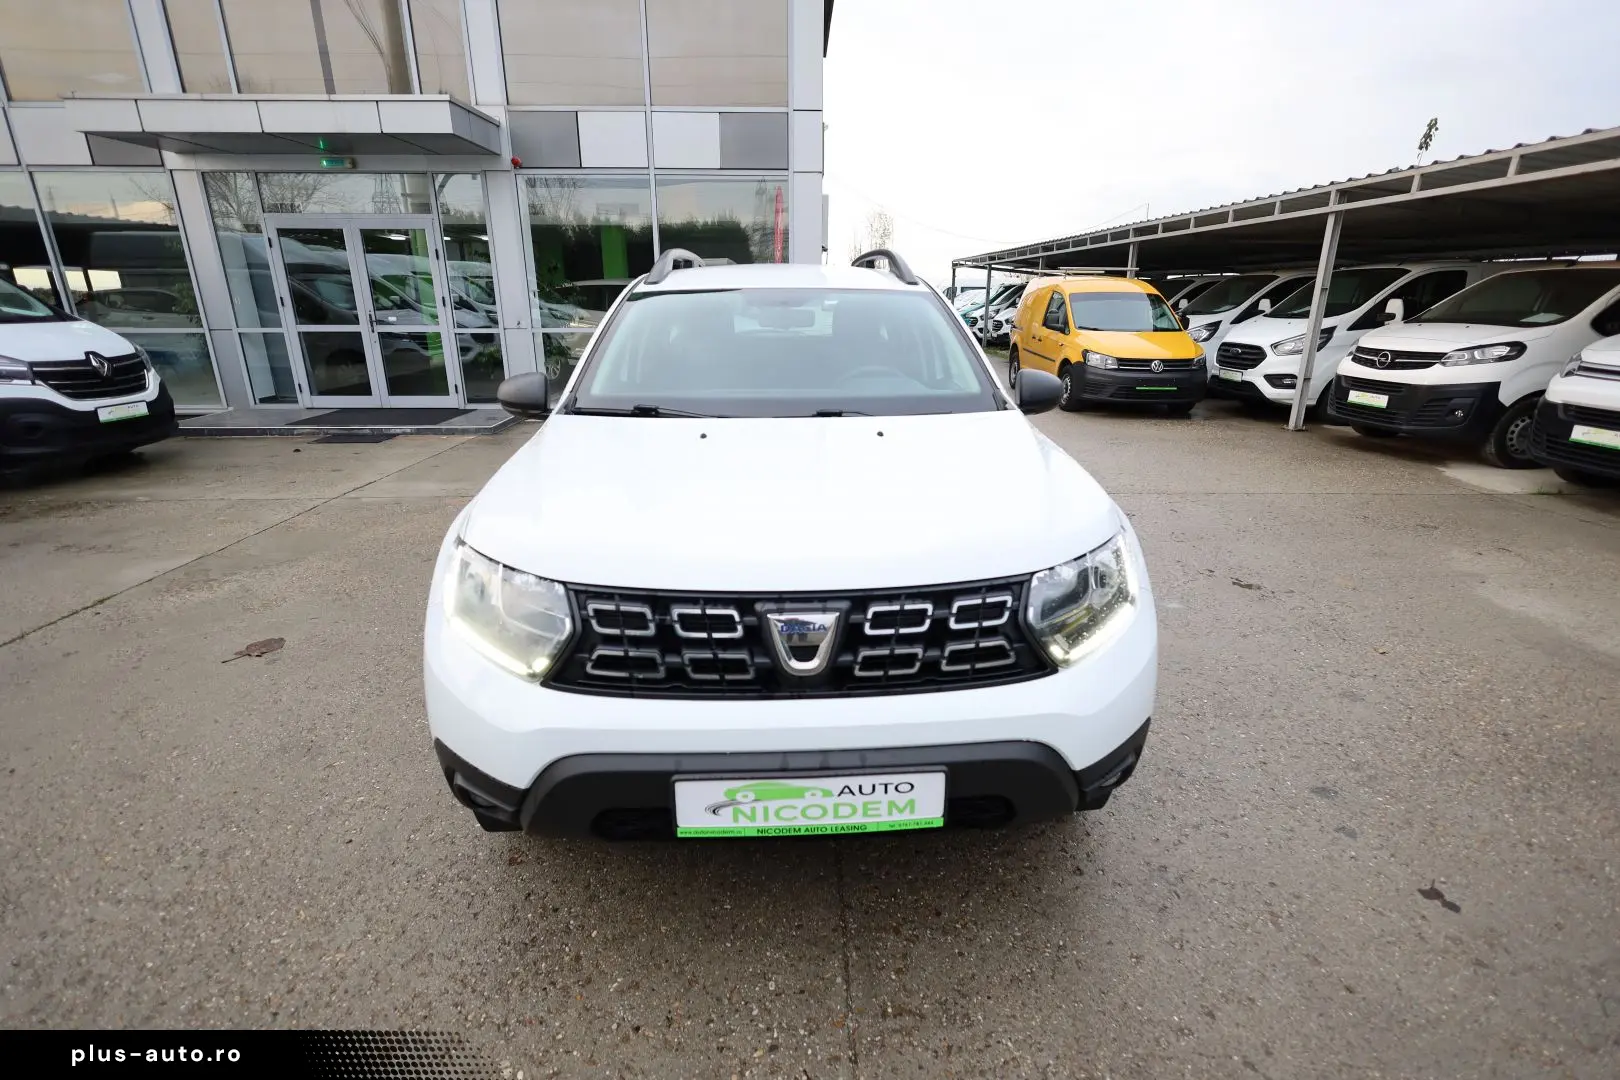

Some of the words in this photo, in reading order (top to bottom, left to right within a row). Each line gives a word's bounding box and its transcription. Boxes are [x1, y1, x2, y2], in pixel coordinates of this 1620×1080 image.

[837, 782, 915, 798] AUTO
[732, 799, 916, 824] NICODEM
[756, 827, 802, 836] NICODEM
[804, 824, 828, 833] AUTO
[830, 823, 868, 833] LEASING
